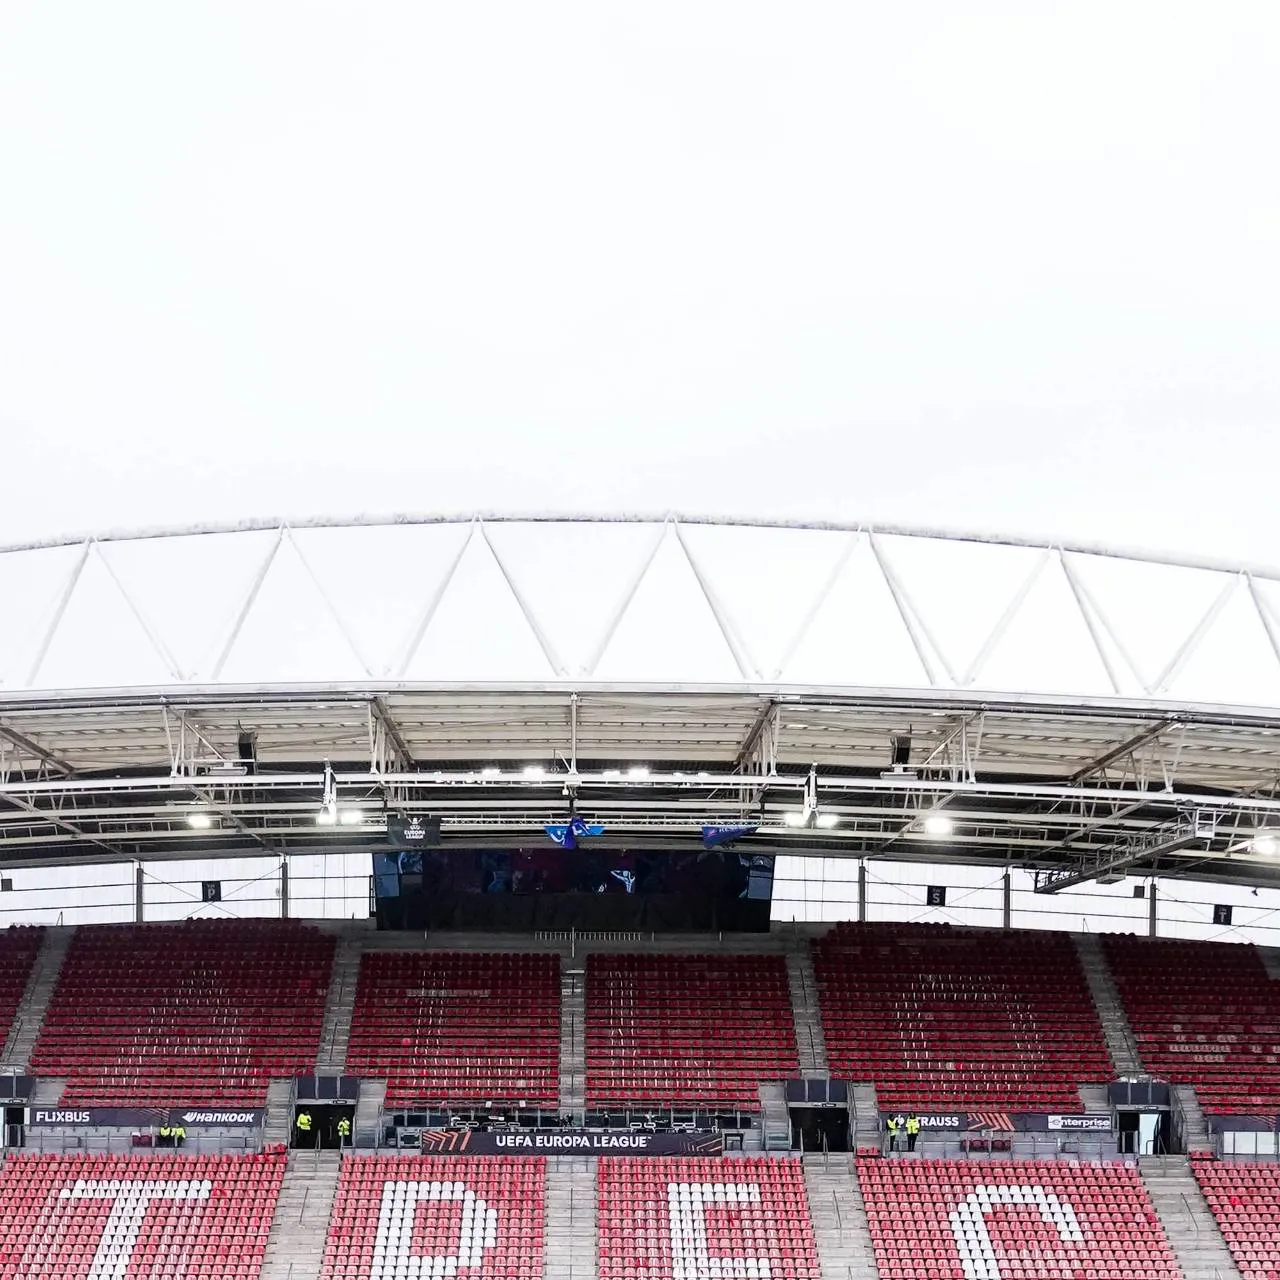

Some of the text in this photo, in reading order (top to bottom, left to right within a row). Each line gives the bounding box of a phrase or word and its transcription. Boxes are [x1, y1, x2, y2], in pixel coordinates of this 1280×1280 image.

[916, 1116, 959, 1127] RAUSS
[496, 1135, 647, 1148] UEFA EUROPA LEAGUE
